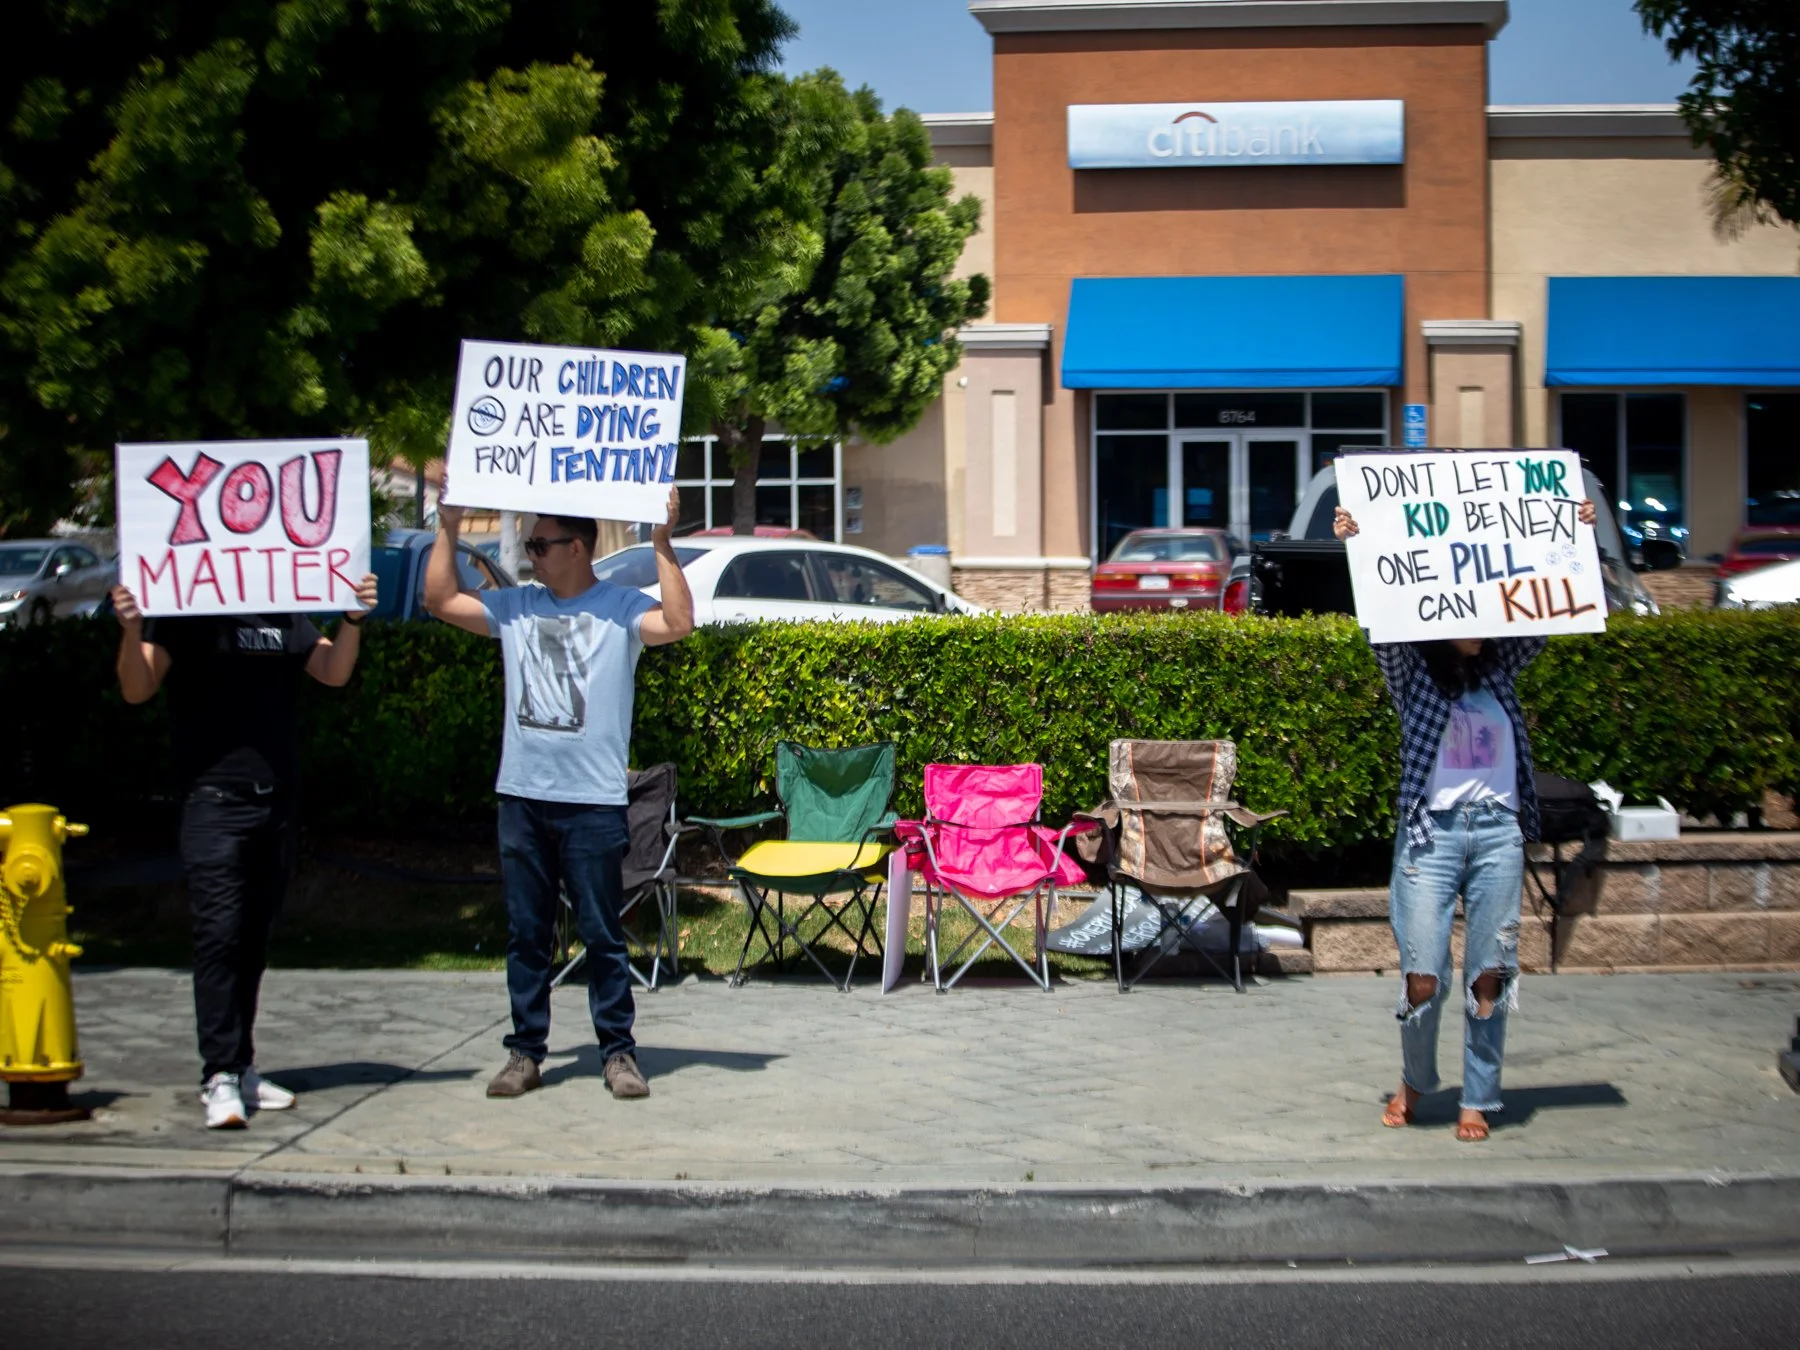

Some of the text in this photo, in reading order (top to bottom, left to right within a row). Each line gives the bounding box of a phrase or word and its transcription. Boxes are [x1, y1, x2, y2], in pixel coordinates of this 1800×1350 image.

[1147, 111, 1324, 157] citibank
[484, 354, 544, 393] OUR
[515, 402, 565, 439] ARE
[475, 441, 538, 485] FROM
[1361, 457, 1570, 501] DONT LET YOUR
[145, 449, 343, 548] YOU
[1403, 497, 1582, 545] KID BE NEXT
[137, 547, 357, 610] MATTER
[1377, 541, 1535, 586] ONE PILL
[1418, 576, 1597, 623] CAN KILL
